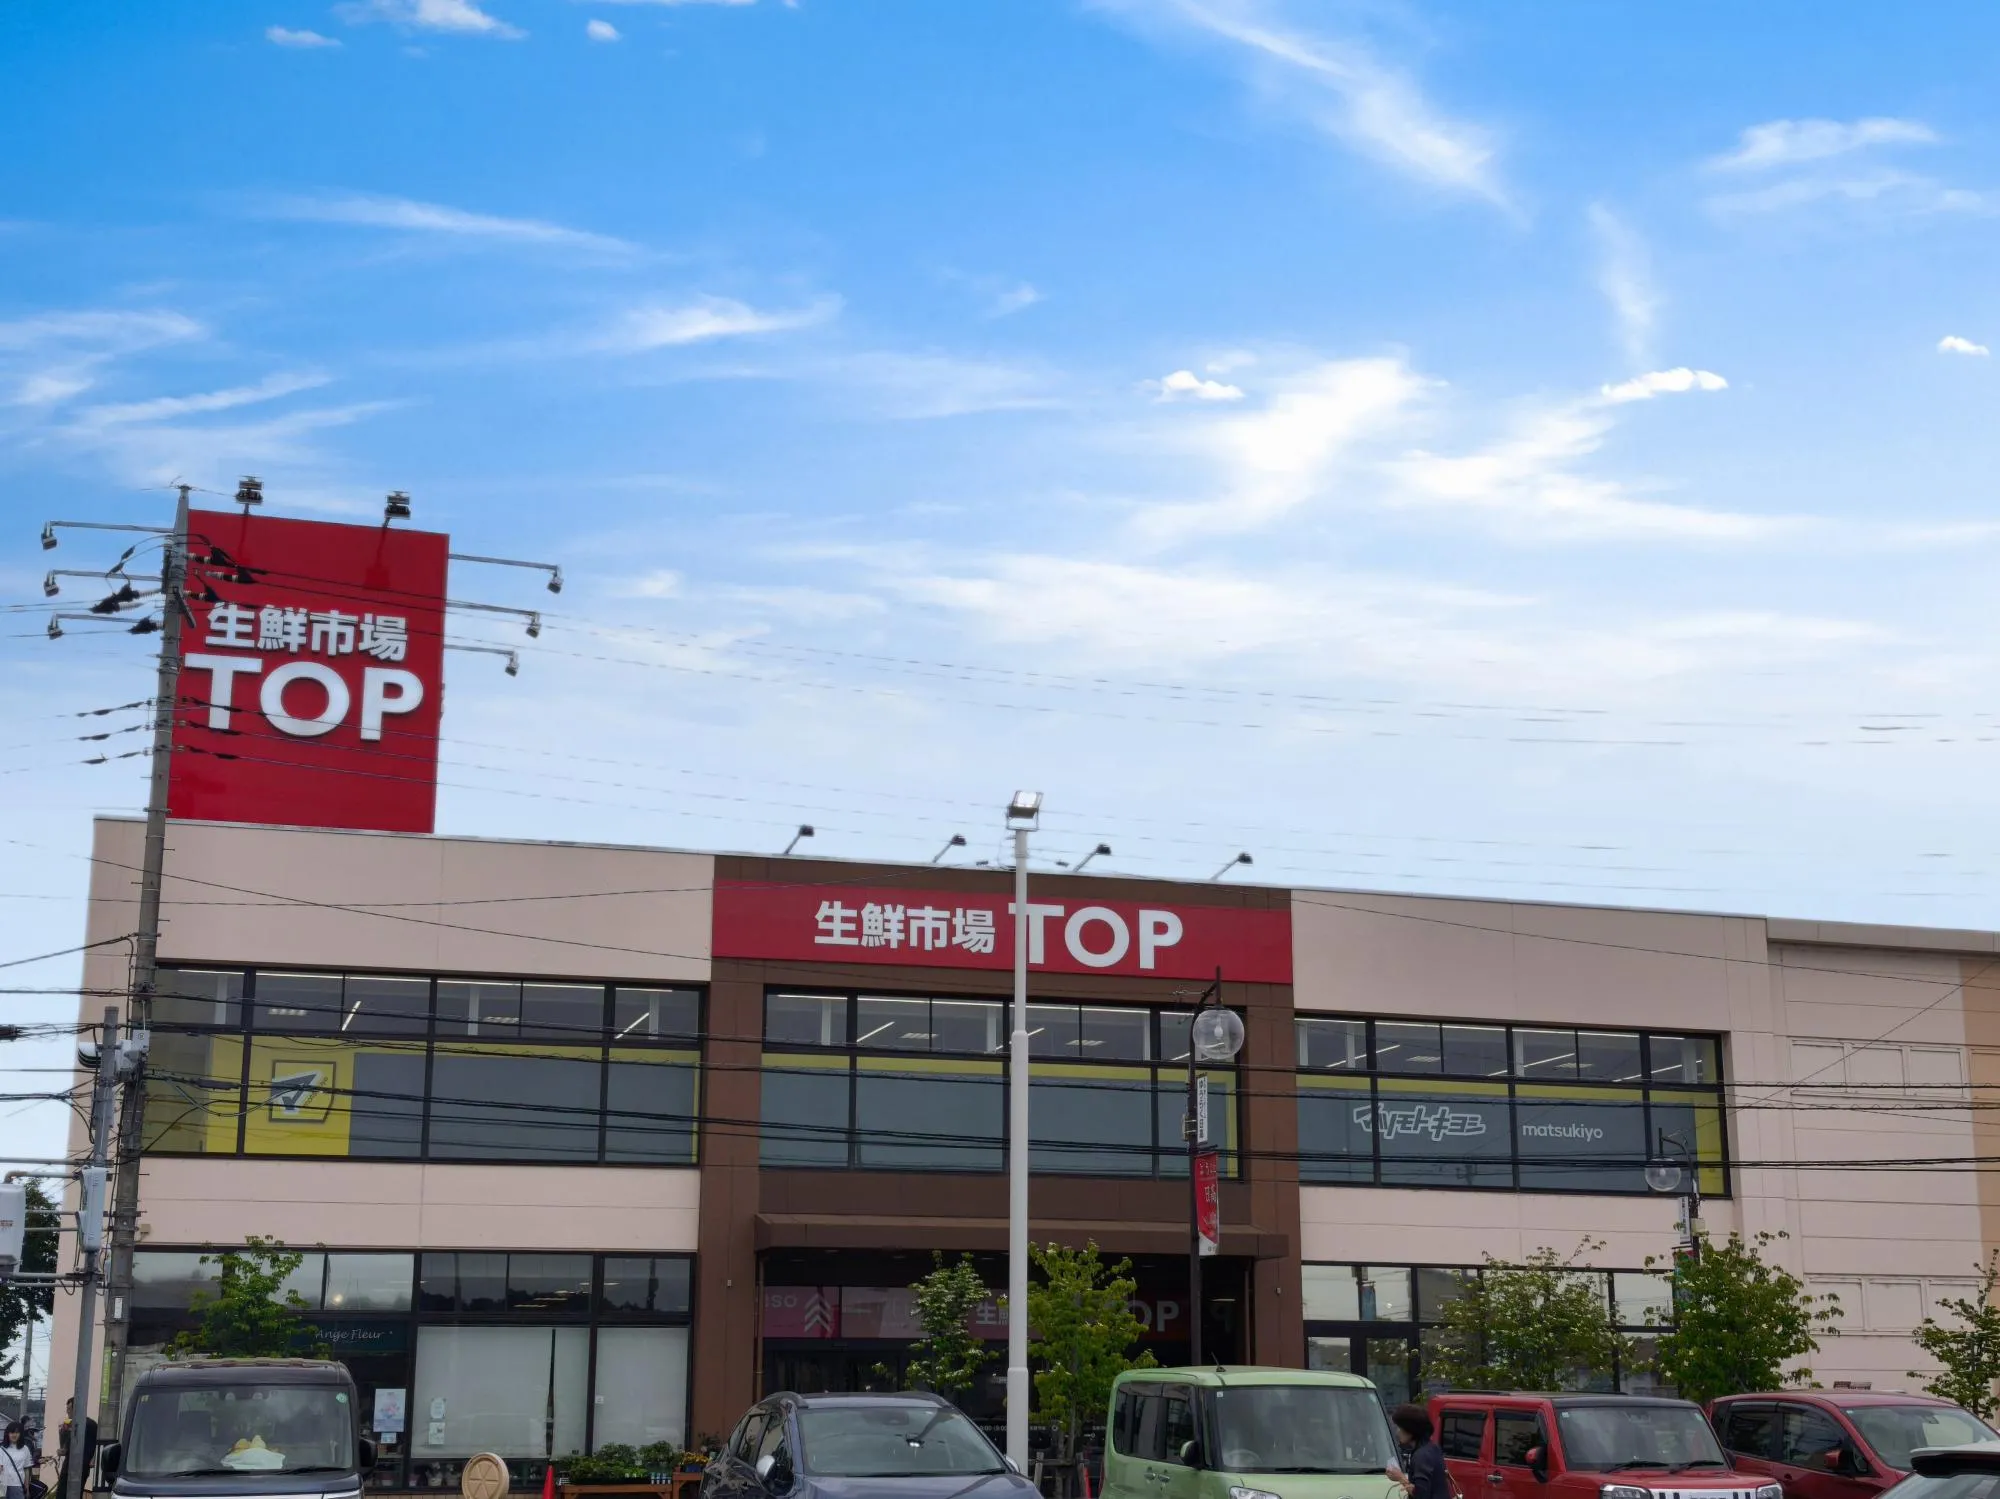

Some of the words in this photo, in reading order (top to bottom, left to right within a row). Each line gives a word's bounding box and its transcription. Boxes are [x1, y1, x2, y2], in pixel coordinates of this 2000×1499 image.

[205, 602, 408, 661] 生鮮市場
[185, 652, 424, 741] TOP
[814, 900, 996, 954] 生鮮市場
[1008, 902, 1184, 970] TOP
[1522, 1123, 1603, 1142] matsukiyo
